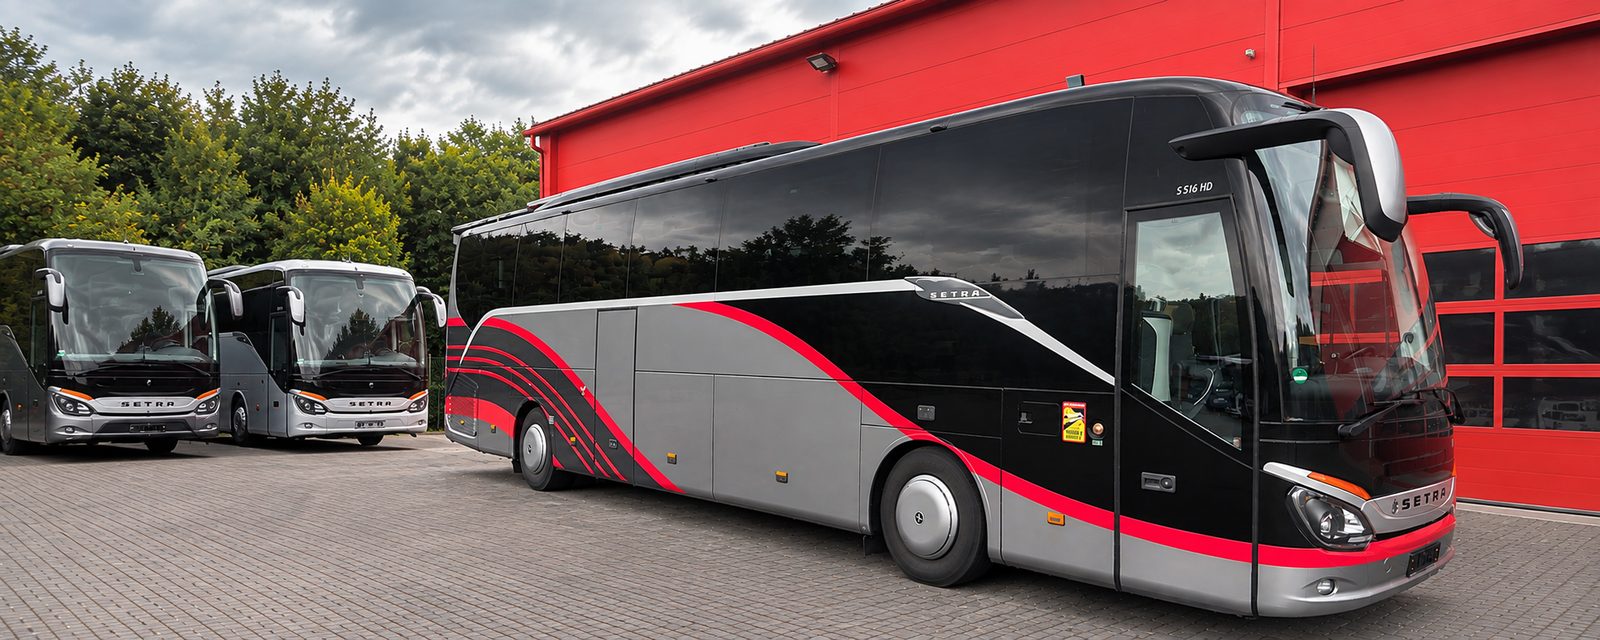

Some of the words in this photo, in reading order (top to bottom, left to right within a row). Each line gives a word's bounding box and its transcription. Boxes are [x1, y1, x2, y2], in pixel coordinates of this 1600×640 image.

[1176, 186, 1183, 196] S
[1183, 184, 1198, 195] 516
[1200, 181, 1213, 192] HD
[930, 290, 980, 298] SETRA
[1402, 487, 1446, 511] SETRA
